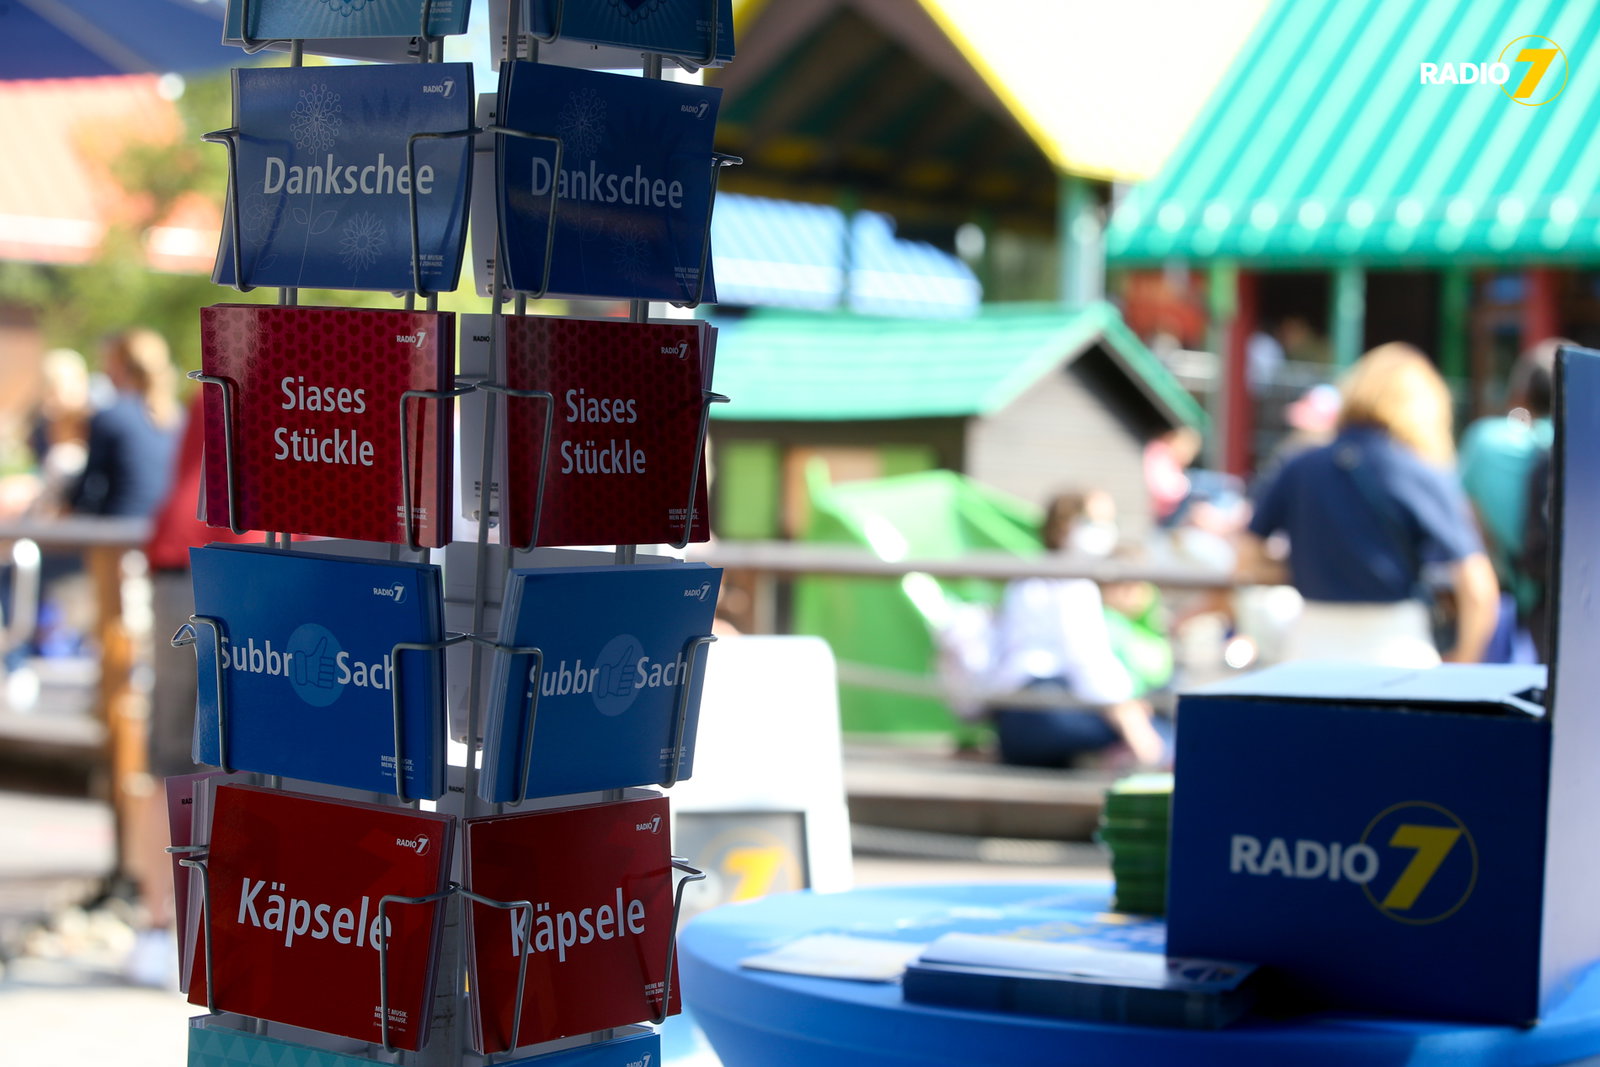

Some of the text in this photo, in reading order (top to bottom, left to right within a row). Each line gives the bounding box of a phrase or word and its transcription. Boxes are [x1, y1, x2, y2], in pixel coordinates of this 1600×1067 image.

[423, 85, 443, 93] RADIO
[680, 104, 699, 114] RADIO
[263, 153, 435, 195] Dankschee
[531, 157, 684, 209] Dankschee
[396, 335, 417, 343] RADIO
[660, 346, 679, 355] RADIO
[281, 376, 366, 414] Siases
[565, 388, 638, 424] Siases
[274, 427, 375, 467] Stückle
[560, 439, 647, 475] Stückle
[373, 587, 395, 597] RADIO
[684, 589, 701, 597] RADIO
[396, 838, 417, 849] RADIO
[636, 822, 653, 831] RADIO
[1230, 823, 1464, 910] RADIO 7
[237, 877, 392, 951] Käpsele
[510, 887, 646, 963] Käpsele
